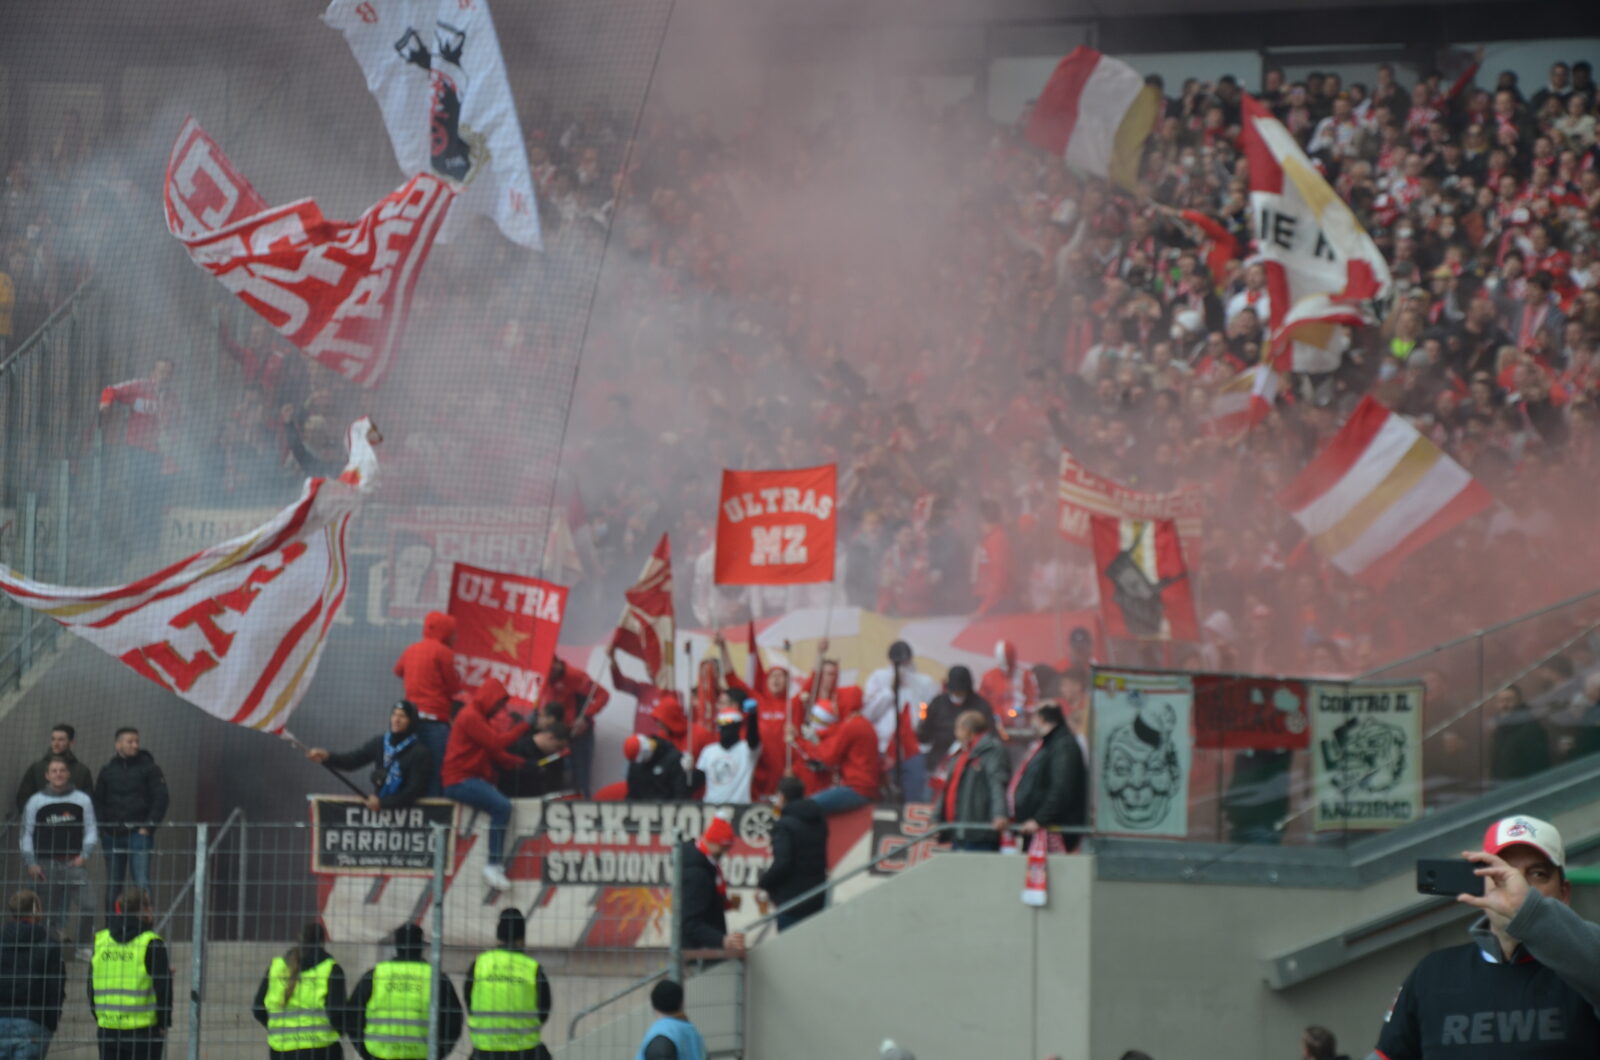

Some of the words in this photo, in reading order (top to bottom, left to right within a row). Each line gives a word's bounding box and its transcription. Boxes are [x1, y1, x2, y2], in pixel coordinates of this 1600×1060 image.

[722, 486, 833, 524] ULTRAS
[749, 524, 809, 566] MZ
[456, 571, 561, 624] ULTRA
[1318, 693, 1390, 713] CONTRO
[1395, 693, 1412, 712] IL
[345, 807, 424, 828] CURVA
[1440, 1007, 1566, 1046] REWE
